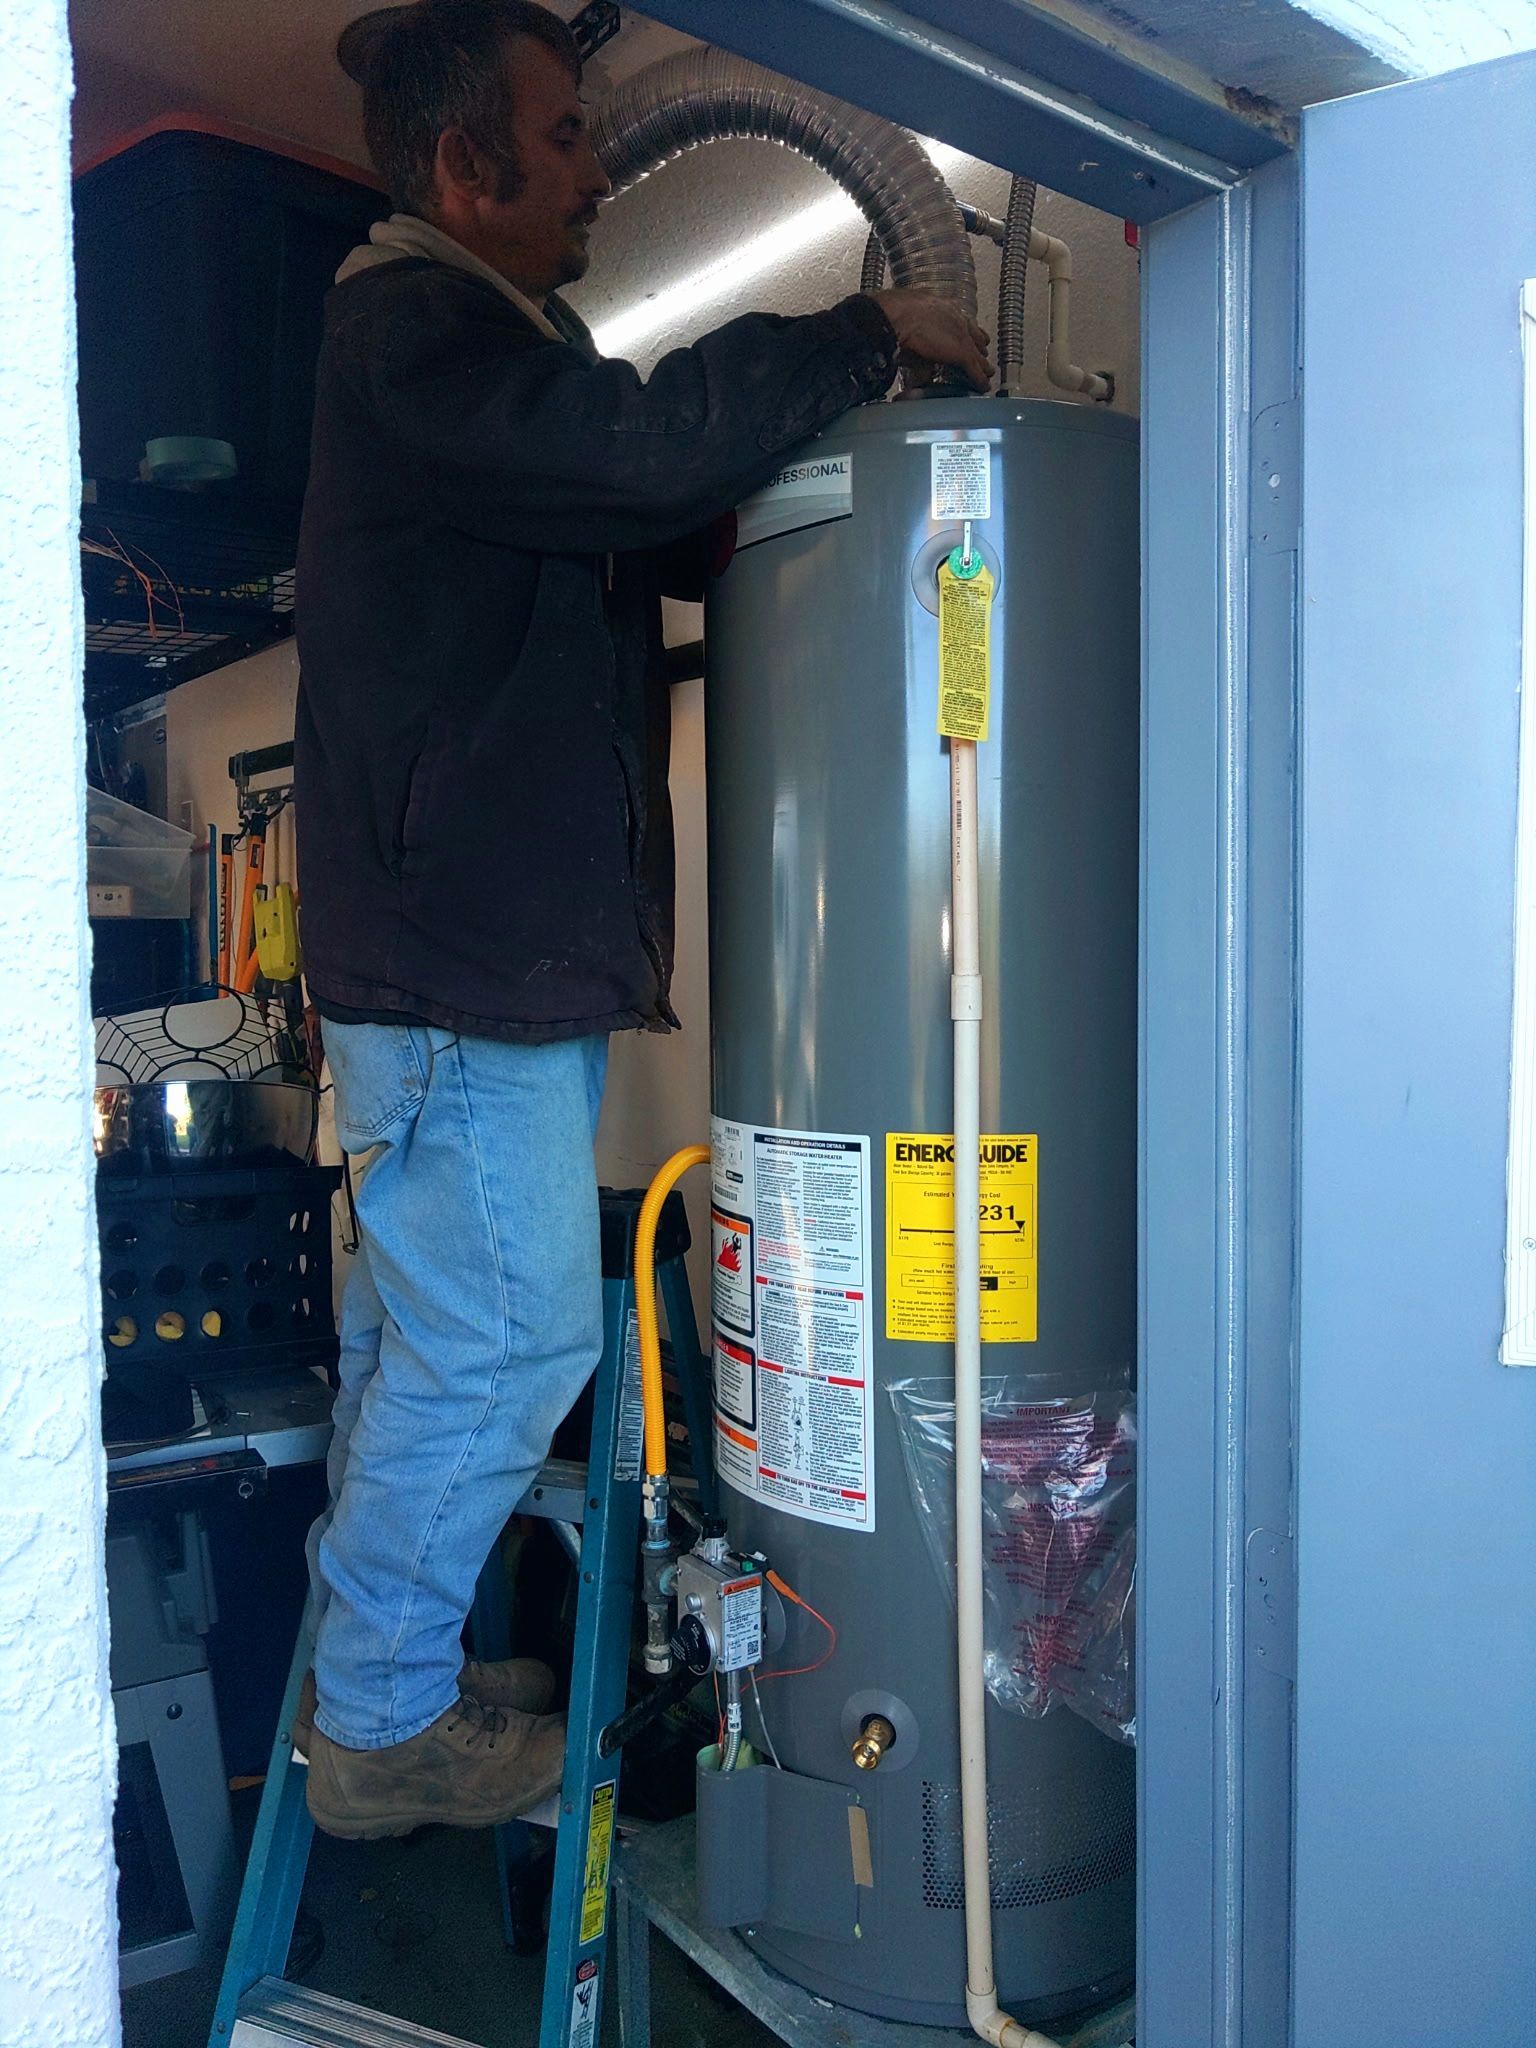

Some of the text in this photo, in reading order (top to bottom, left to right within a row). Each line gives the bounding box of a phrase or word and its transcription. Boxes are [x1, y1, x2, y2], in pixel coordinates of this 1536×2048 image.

[763, 462, 847, 488] OFESSIONAL
[800, 1140, 826, 1149] OPERATION
[826, 1142, 846, 1150] DETAILS
[789, 1150, 808, 1158] STORAGE
[823, 1289, 844, 1298] OPERATING
[784, 1368, 826, 1382] LIGHTING INSTRUCTIONS
[1016, 1406, 1070, 1417] IMPORTANT
[819, 1484, 840, 1495] APPLIANCE
